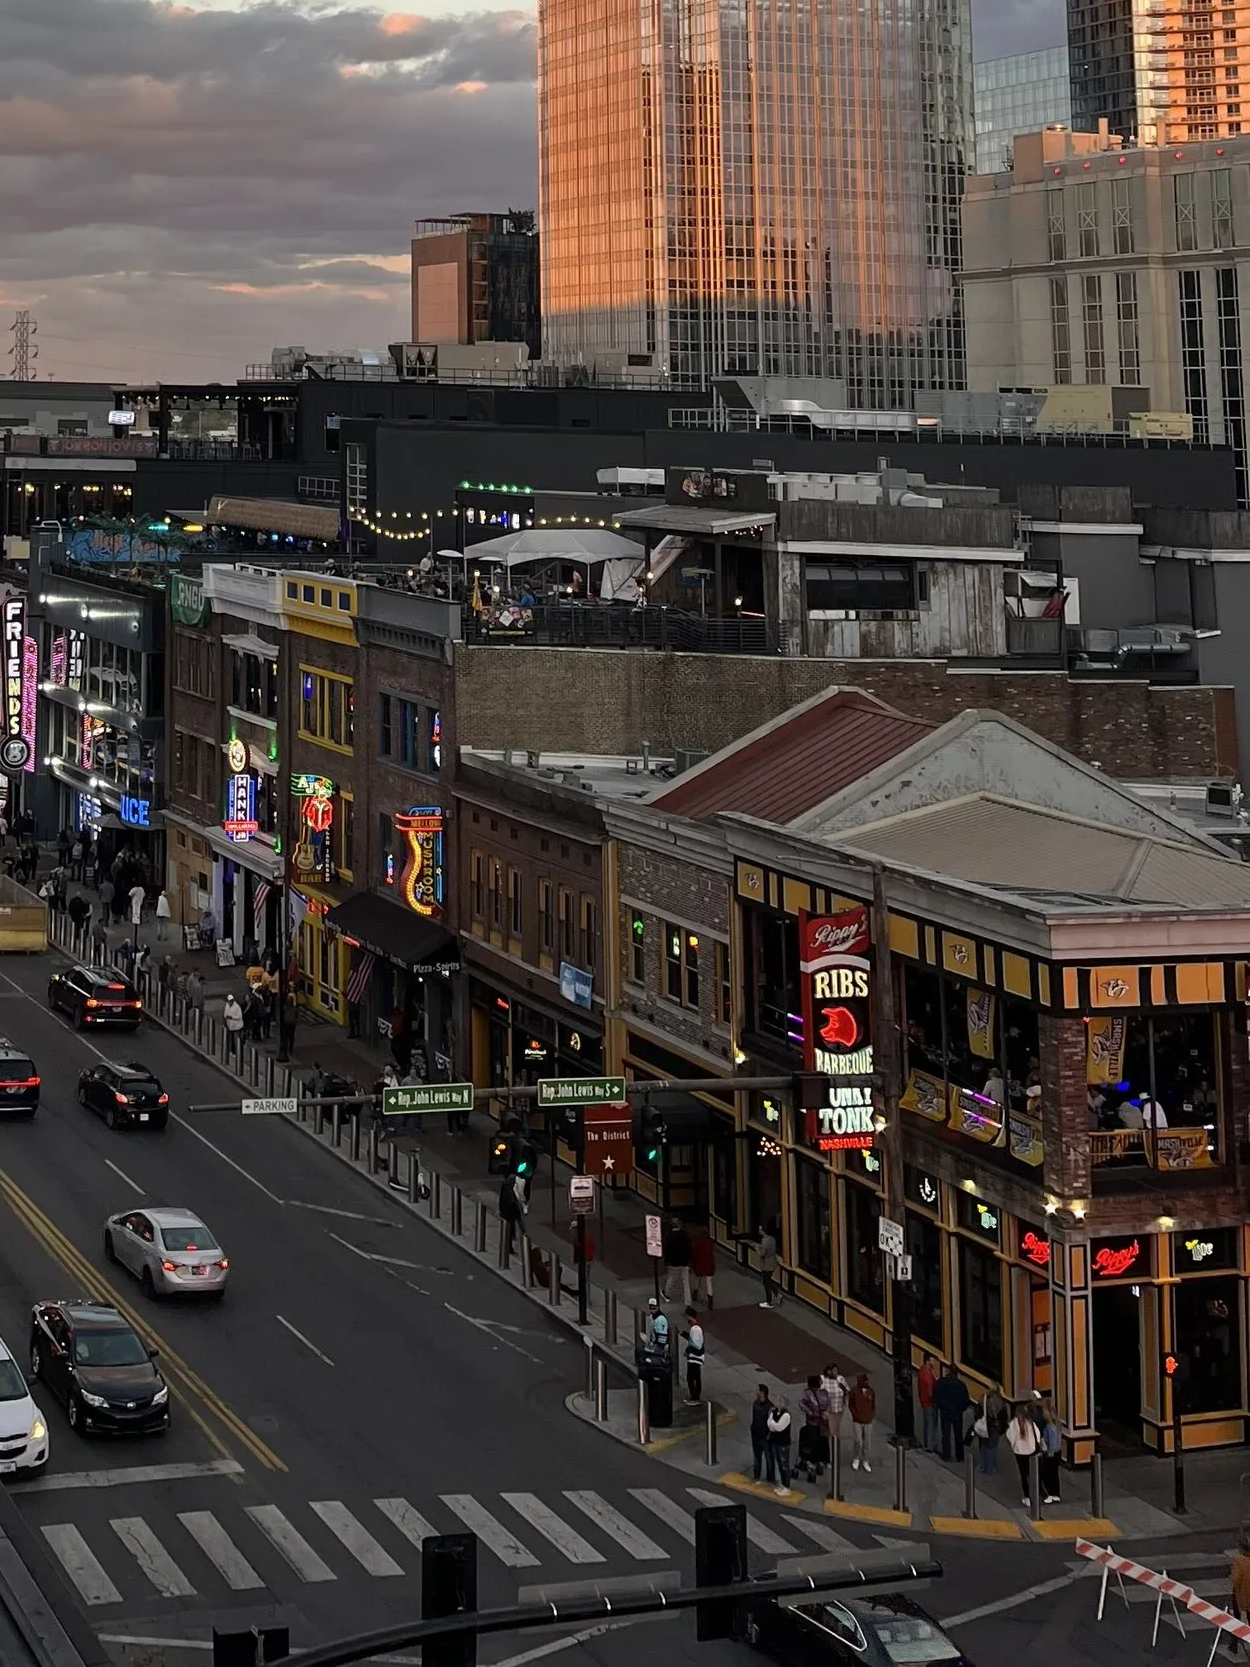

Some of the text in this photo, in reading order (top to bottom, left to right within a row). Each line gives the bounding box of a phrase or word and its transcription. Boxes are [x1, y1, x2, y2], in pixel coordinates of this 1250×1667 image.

[6, 602, 23, 735] FRIENDS
[237, 777, 247, 821] HANK
[410, 819, 441, 828] MELLOW
[423, 832, 434, 904] MUSHROOM
[814, 968, 869, 999] RIBS
[814, 1044, 874, 1075] BARBEQUE
[413, 1090, 429, 1105] John
[430, 1089, 451, 1104] Lewis
[558, 1083, 573, 1097] John
[573, 1082, 593, 1097] Lewis
[253, 1100, 295, 1112] PARKING
[818, 1106, 875, 1135] TONK
[587, 1130, 630, 1141] The District
[818, 1136, 873, 1151] NASHVILLE
